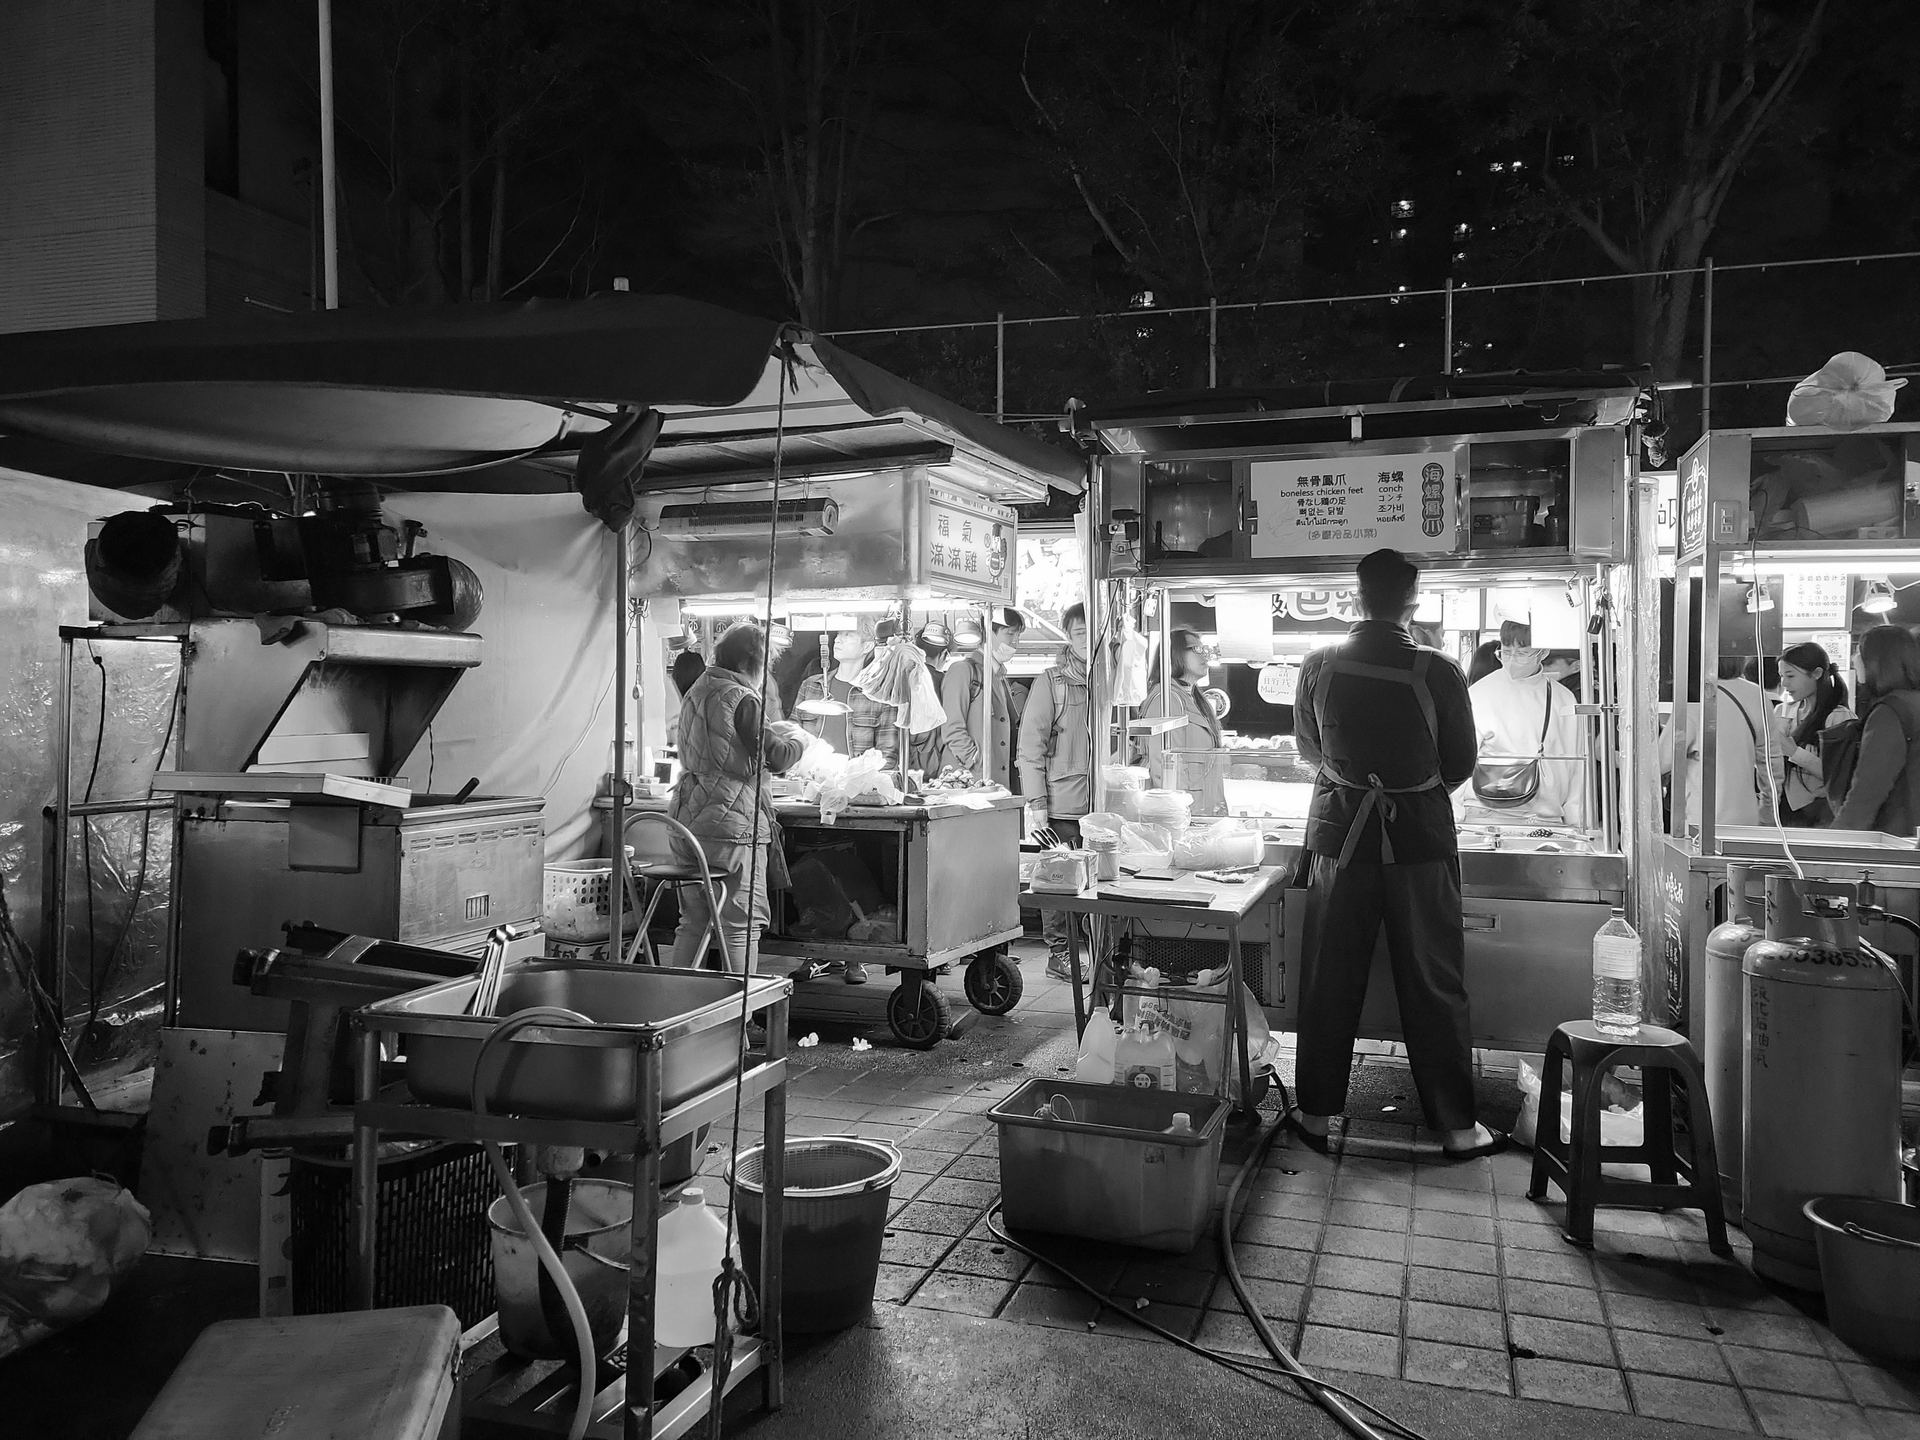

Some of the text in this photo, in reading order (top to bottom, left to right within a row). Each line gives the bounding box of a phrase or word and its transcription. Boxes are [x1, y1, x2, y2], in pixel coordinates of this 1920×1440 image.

[1297, 474, 1347, 487] 無骨鳳爪
[1377, 471, 1404, 484] 海螺
[1281, 485, 1364, 497] boneless chicken feet
[1378, 484, 1403, 493] conch
